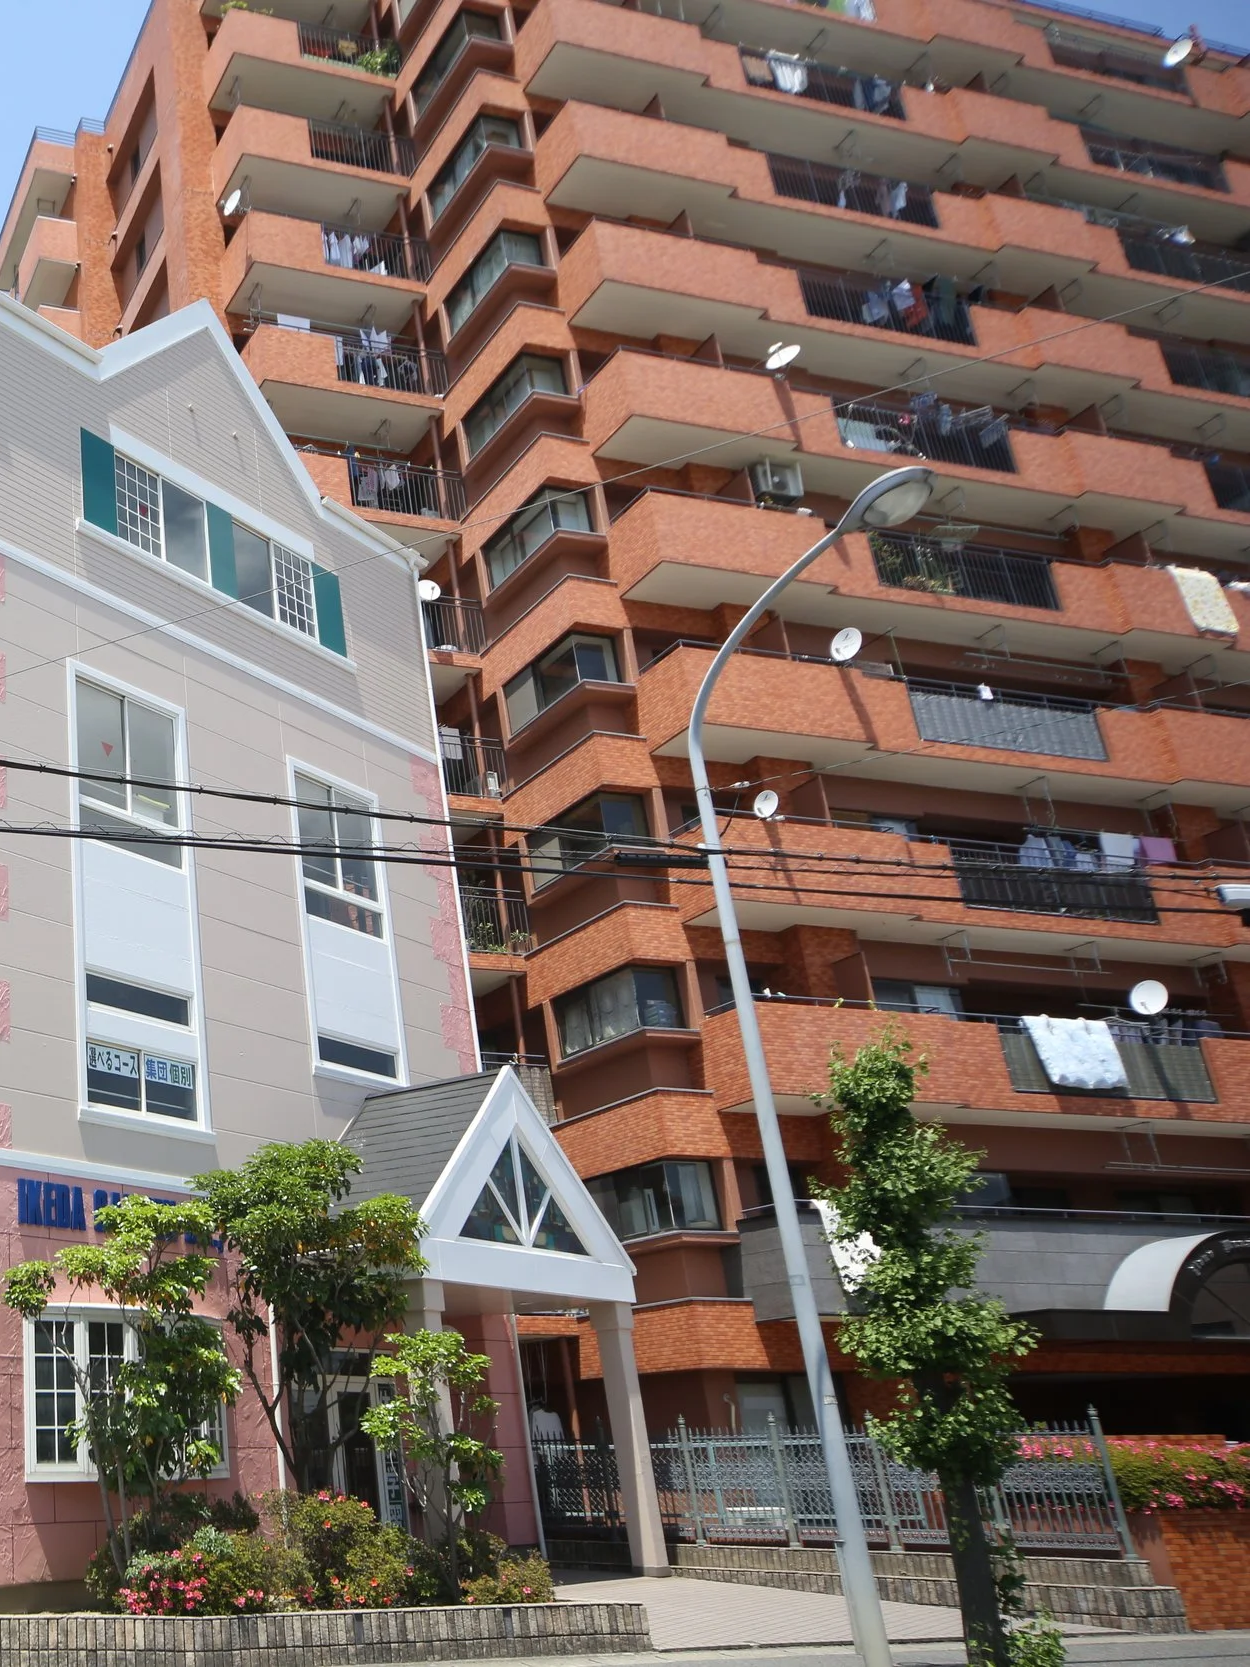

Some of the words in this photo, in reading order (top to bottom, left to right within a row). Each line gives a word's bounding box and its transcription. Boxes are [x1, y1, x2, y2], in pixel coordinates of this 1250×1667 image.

[89, 1047, 137, 1075] 選べるコース
[146, 1058, 168, 1081] 集団
[170, 1063, 192, 1087] 個別
[17, 1178, 86, 1231] IKEDA
